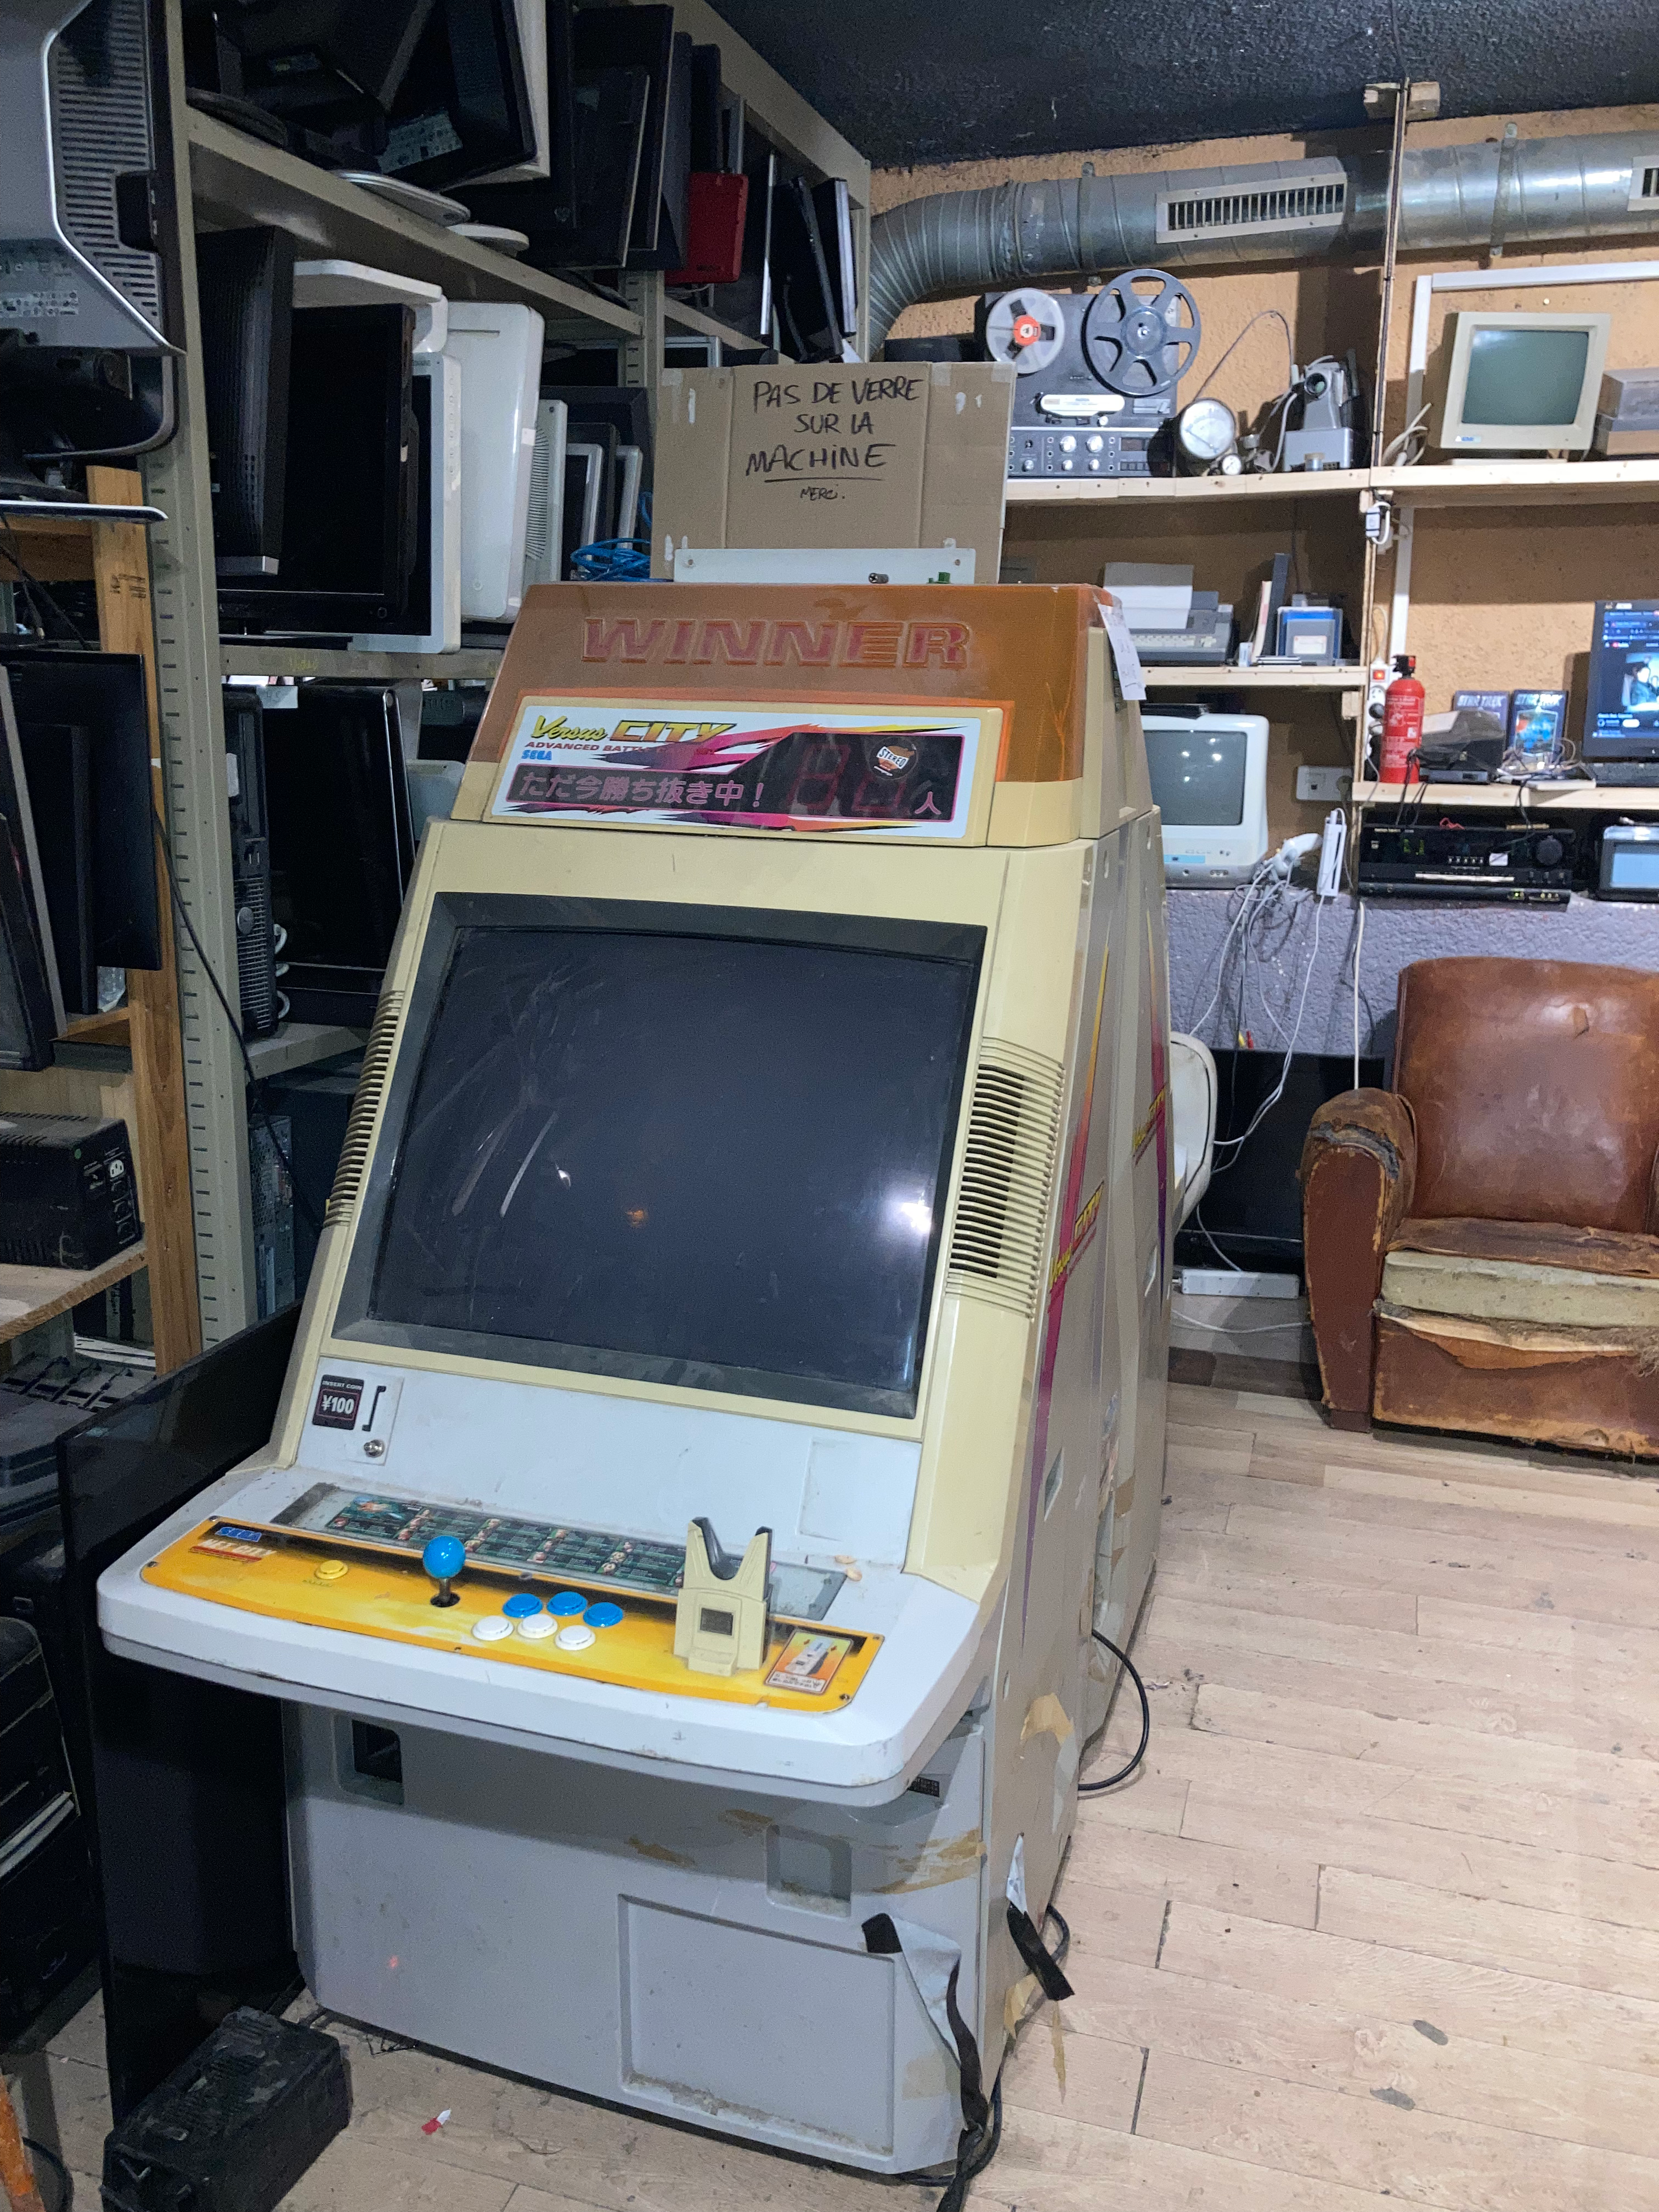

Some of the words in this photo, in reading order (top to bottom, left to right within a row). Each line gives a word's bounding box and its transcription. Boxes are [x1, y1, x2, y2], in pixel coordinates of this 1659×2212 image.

[754, 381, 801, 413] PAS
[811, 382, 844, 404] DE
[852, 376, 924, 405] VERRE
[794, 413, 842, 435] SUR
[851, 411, 874, 434] LA
[582, 617, 970, 670] WINNER
[531, 715, 608, 742] Versus
[610, 720, 737, 742] CITY
[521, 750, 552, 761] SEGA
[524, 741, 599, 752] ADVANCED
[879, 748, 907, 767] STEREO
[914, 791, 942, 815] 人
[321, 1395, 354, 1414] ¥100
[215, 1526, 262, 1543] SEGA
